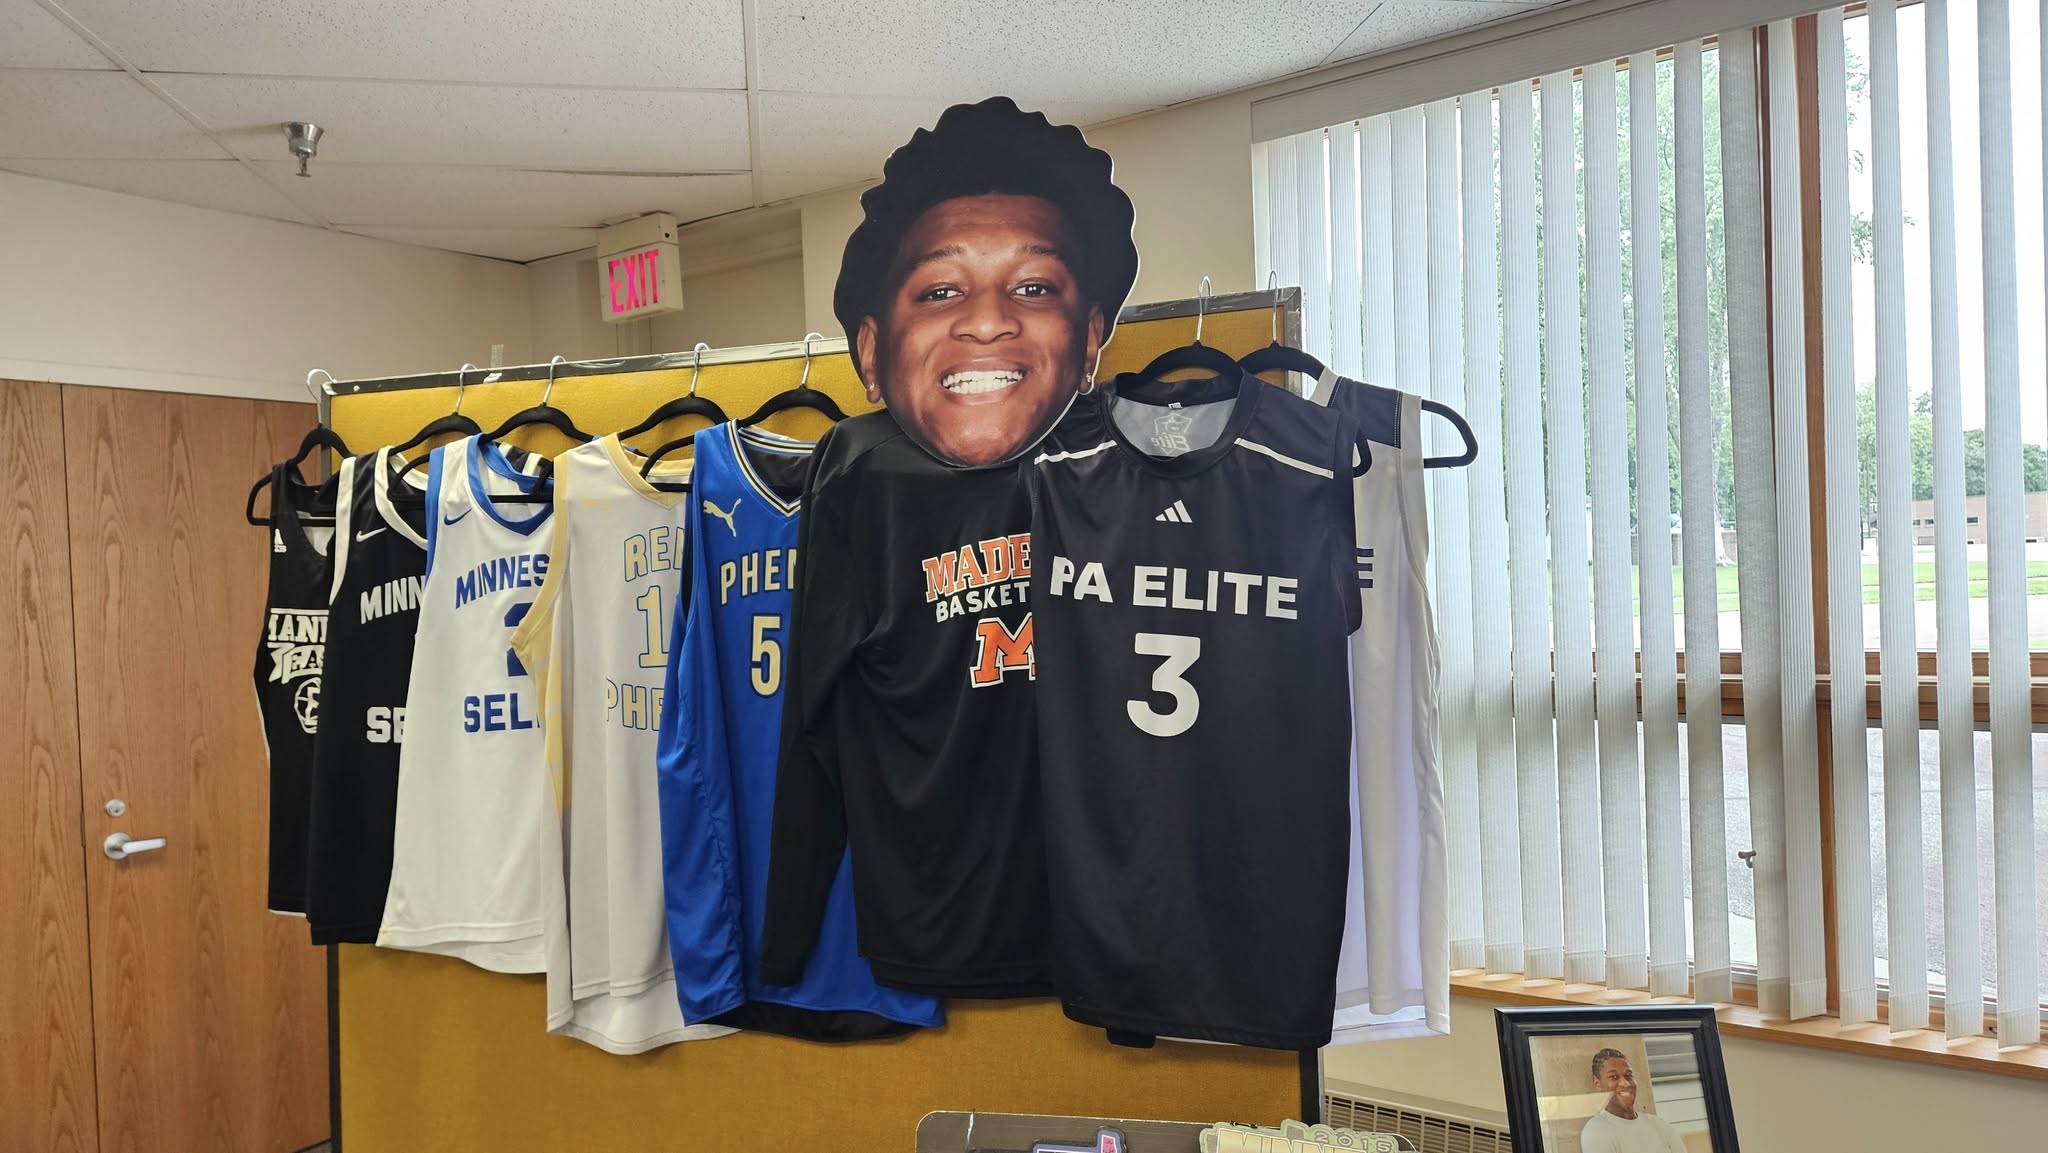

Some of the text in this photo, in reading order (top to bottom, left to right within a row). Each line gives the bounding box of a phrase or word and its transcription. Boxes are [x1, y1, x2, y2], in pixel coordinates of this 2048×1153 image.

[608, 248, 658, 314] EXIT
[936, 581, 1031, 623] BASKET
[1050, 556, 1114, 603] PA
[1133, 565, 1298, 620] ELITE
[751, 614, 781, 697] 5
[1127, 632, 1200, 737] 3
[464, 693, 540, 733] SEL
[1314, 1131, 1392, 1153] 2015
